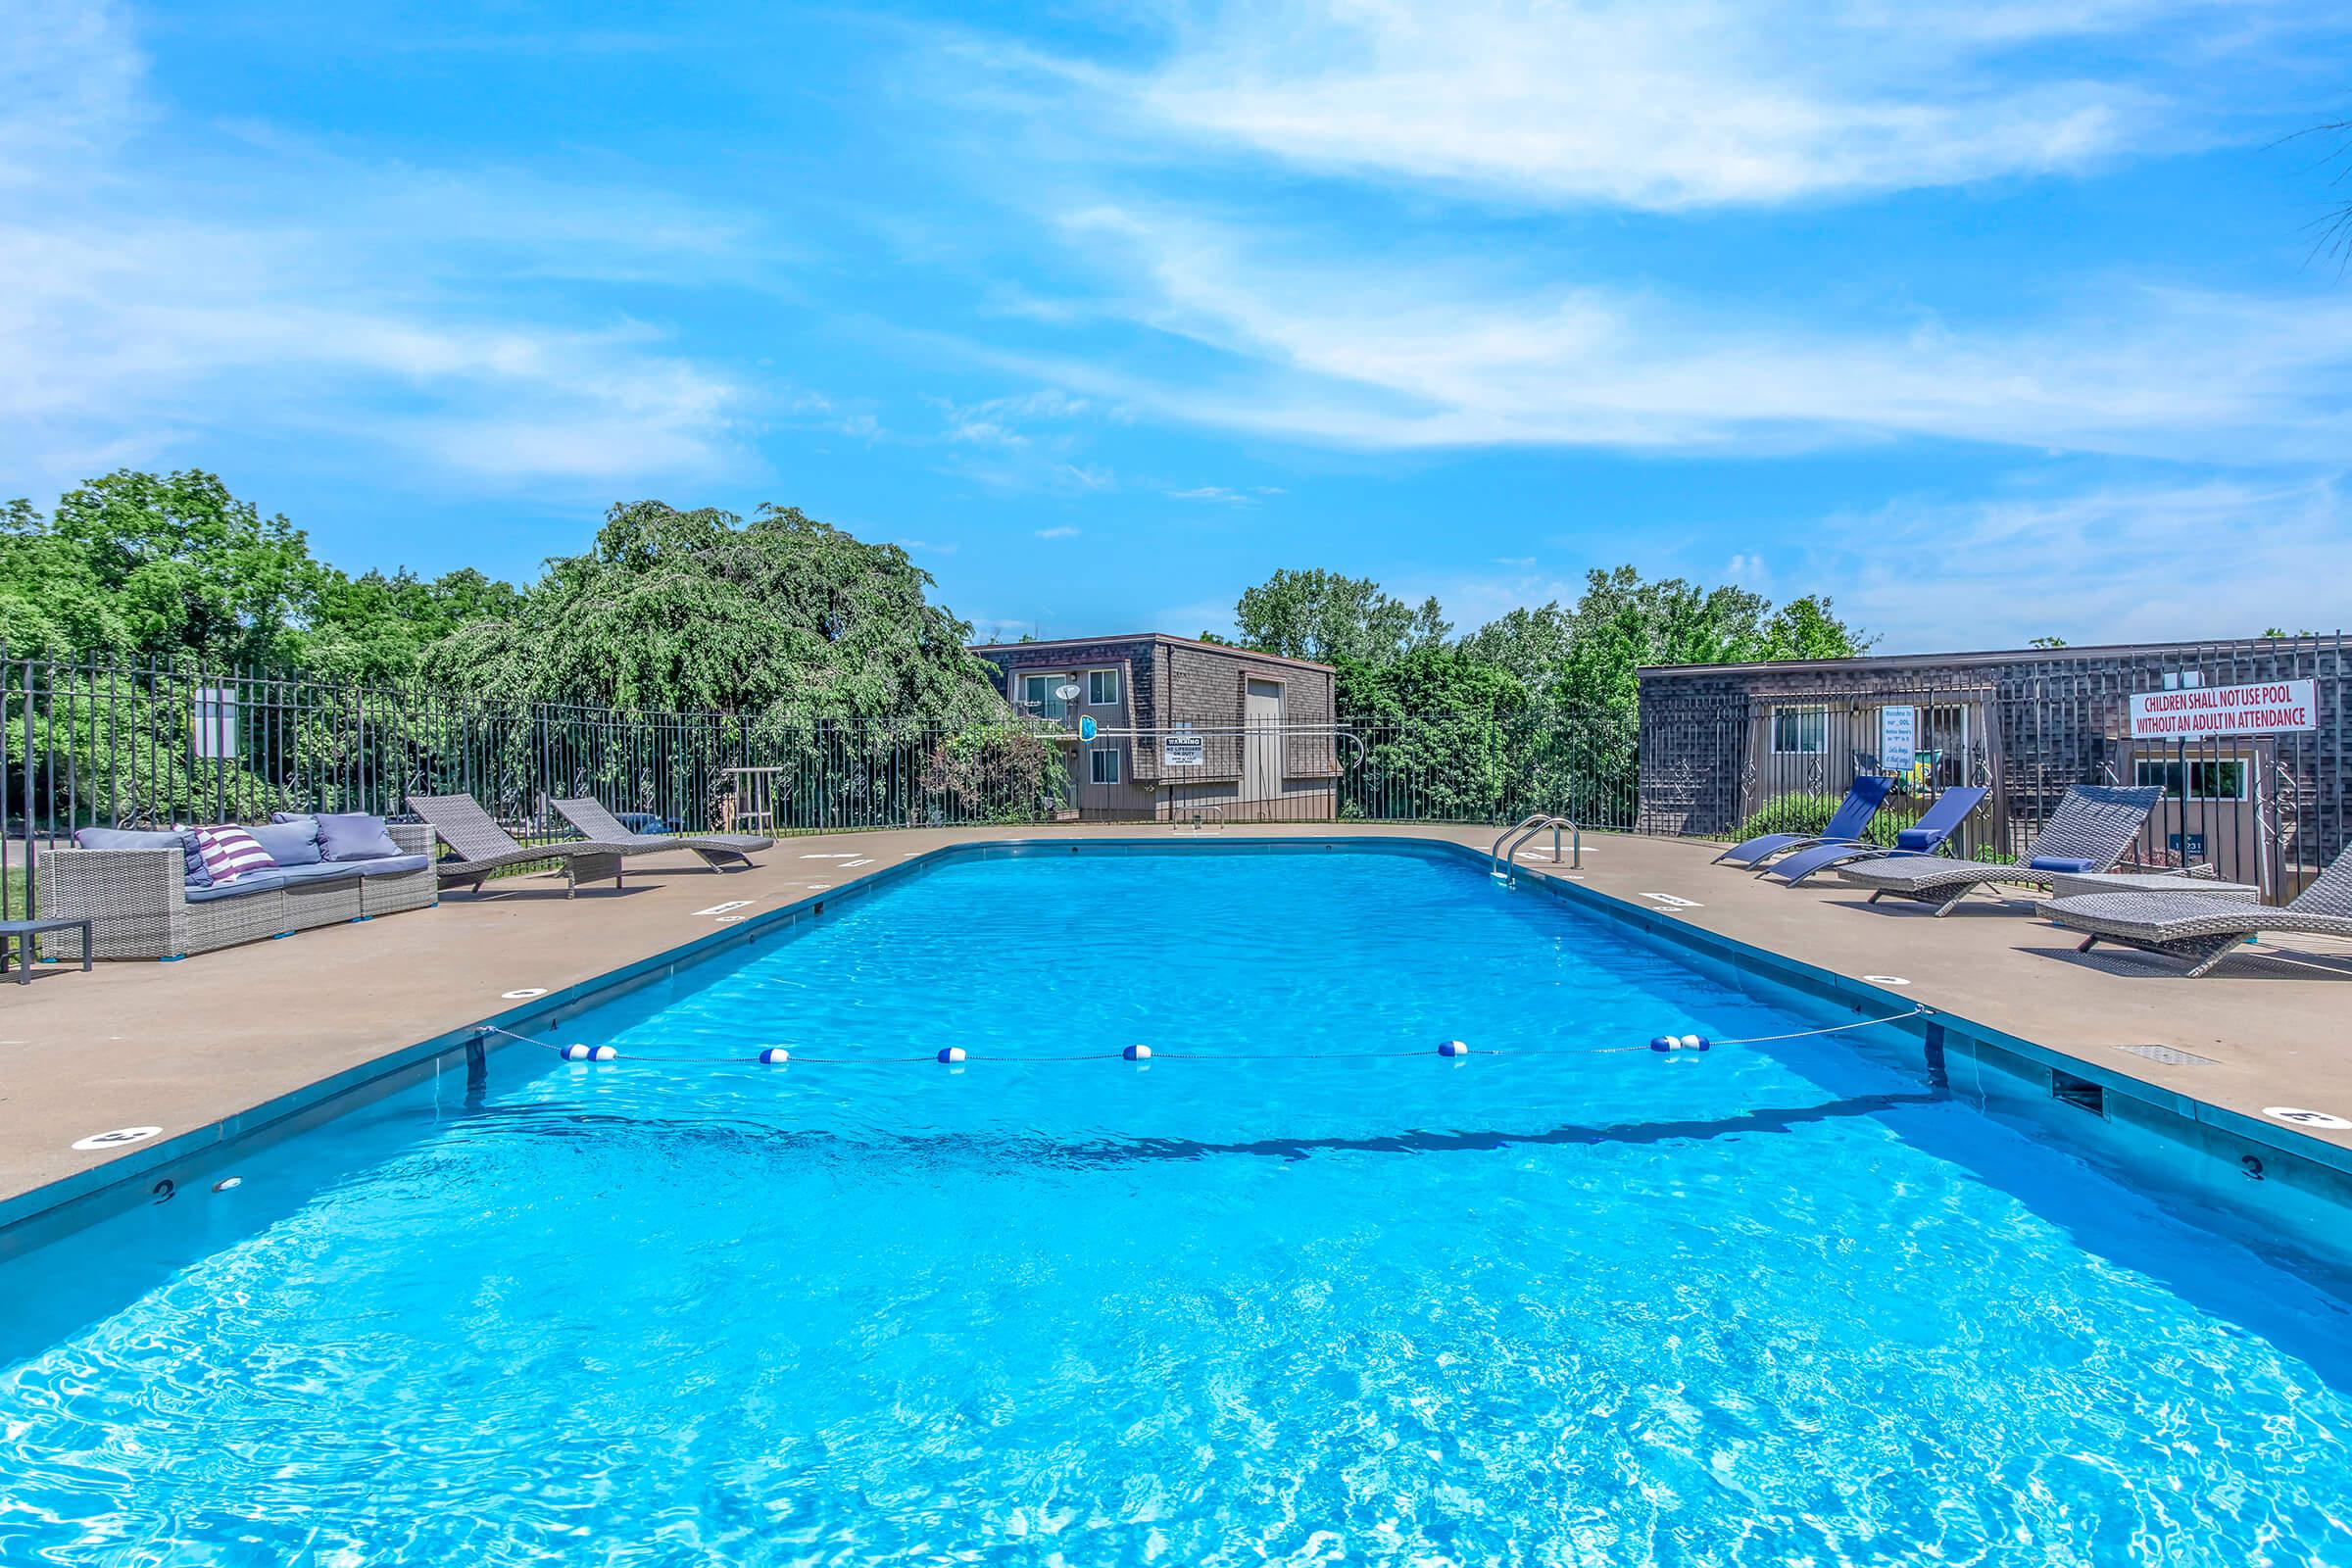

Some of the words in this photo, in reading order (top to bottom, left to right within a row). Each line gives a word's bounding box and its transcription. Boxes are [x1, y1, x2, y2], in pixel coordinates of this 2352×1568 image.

[2144, 694, 2187, 712] CHILDREN
[2188, 691, 2218, 710] SHALL
[2220, 689, 2240, 707] NOT
[2241, 687, 2260, 706] USE
[2262, 685, 2292, 704] POOL
[2136, 715, 2177, 733] WITHOUT
[2178, 714, 2190, 731] AN
[2192, 712, 2223, 731] ADULT
[2225, 711, 2235, 729] IN
[2237, 707, 2305, 728] ATTENDANCE
